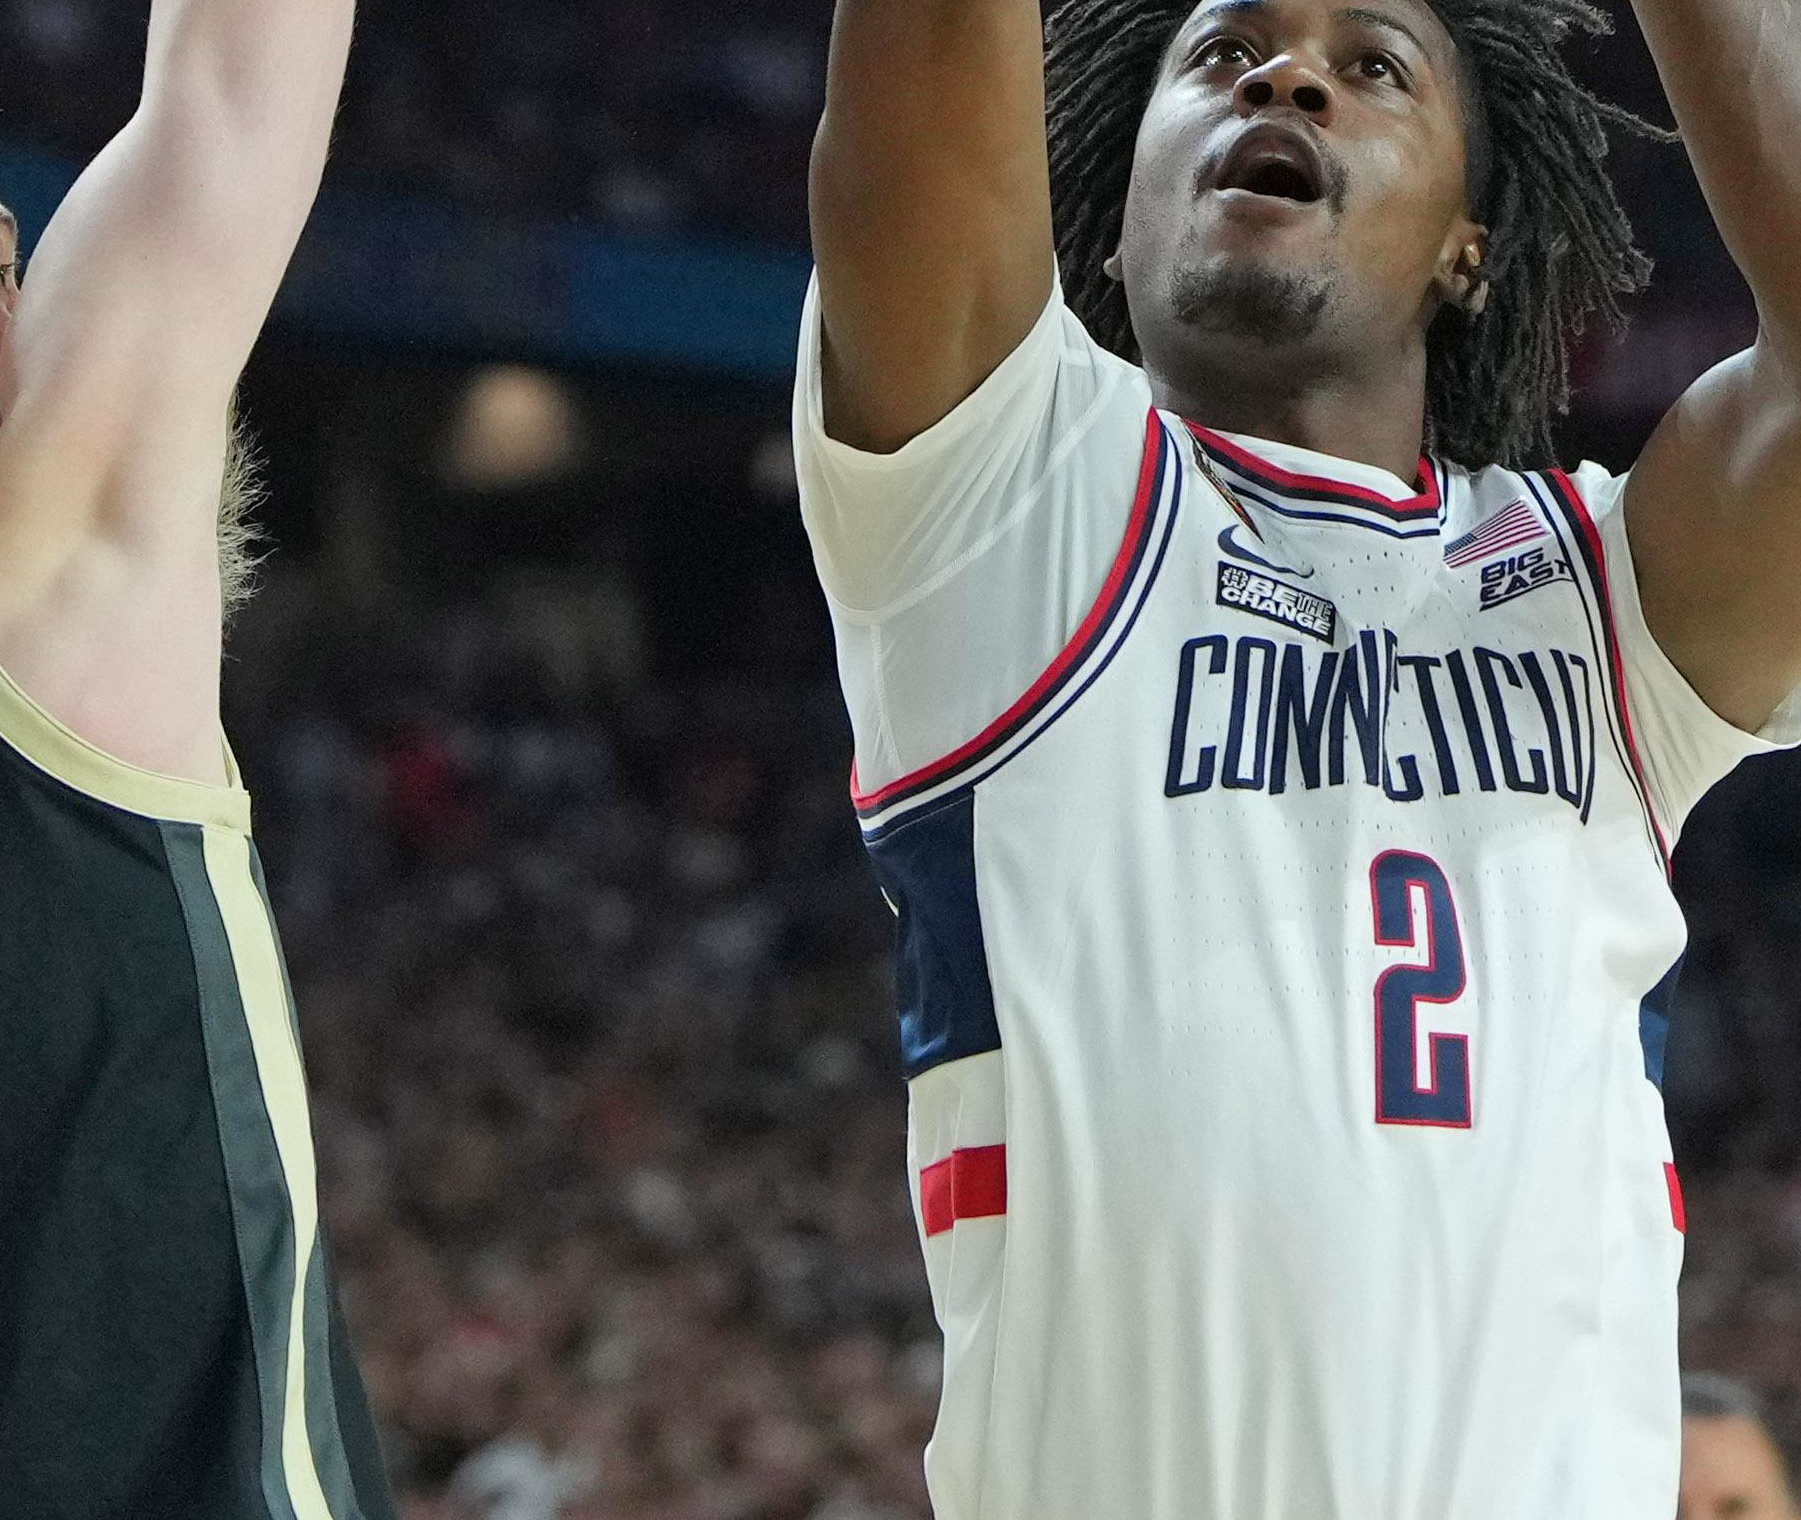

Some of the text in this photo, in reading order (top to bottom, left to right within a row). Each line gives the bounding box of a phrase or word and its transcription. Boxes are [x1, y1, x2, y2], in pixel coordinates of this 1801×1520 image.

[1479, 558, 1574, 603] EAST
[1480, 546, 1545, 586] BIG
[1220, 585, 1332, 637] CHANGE
[1368, 847, 1473, 1130] 2
